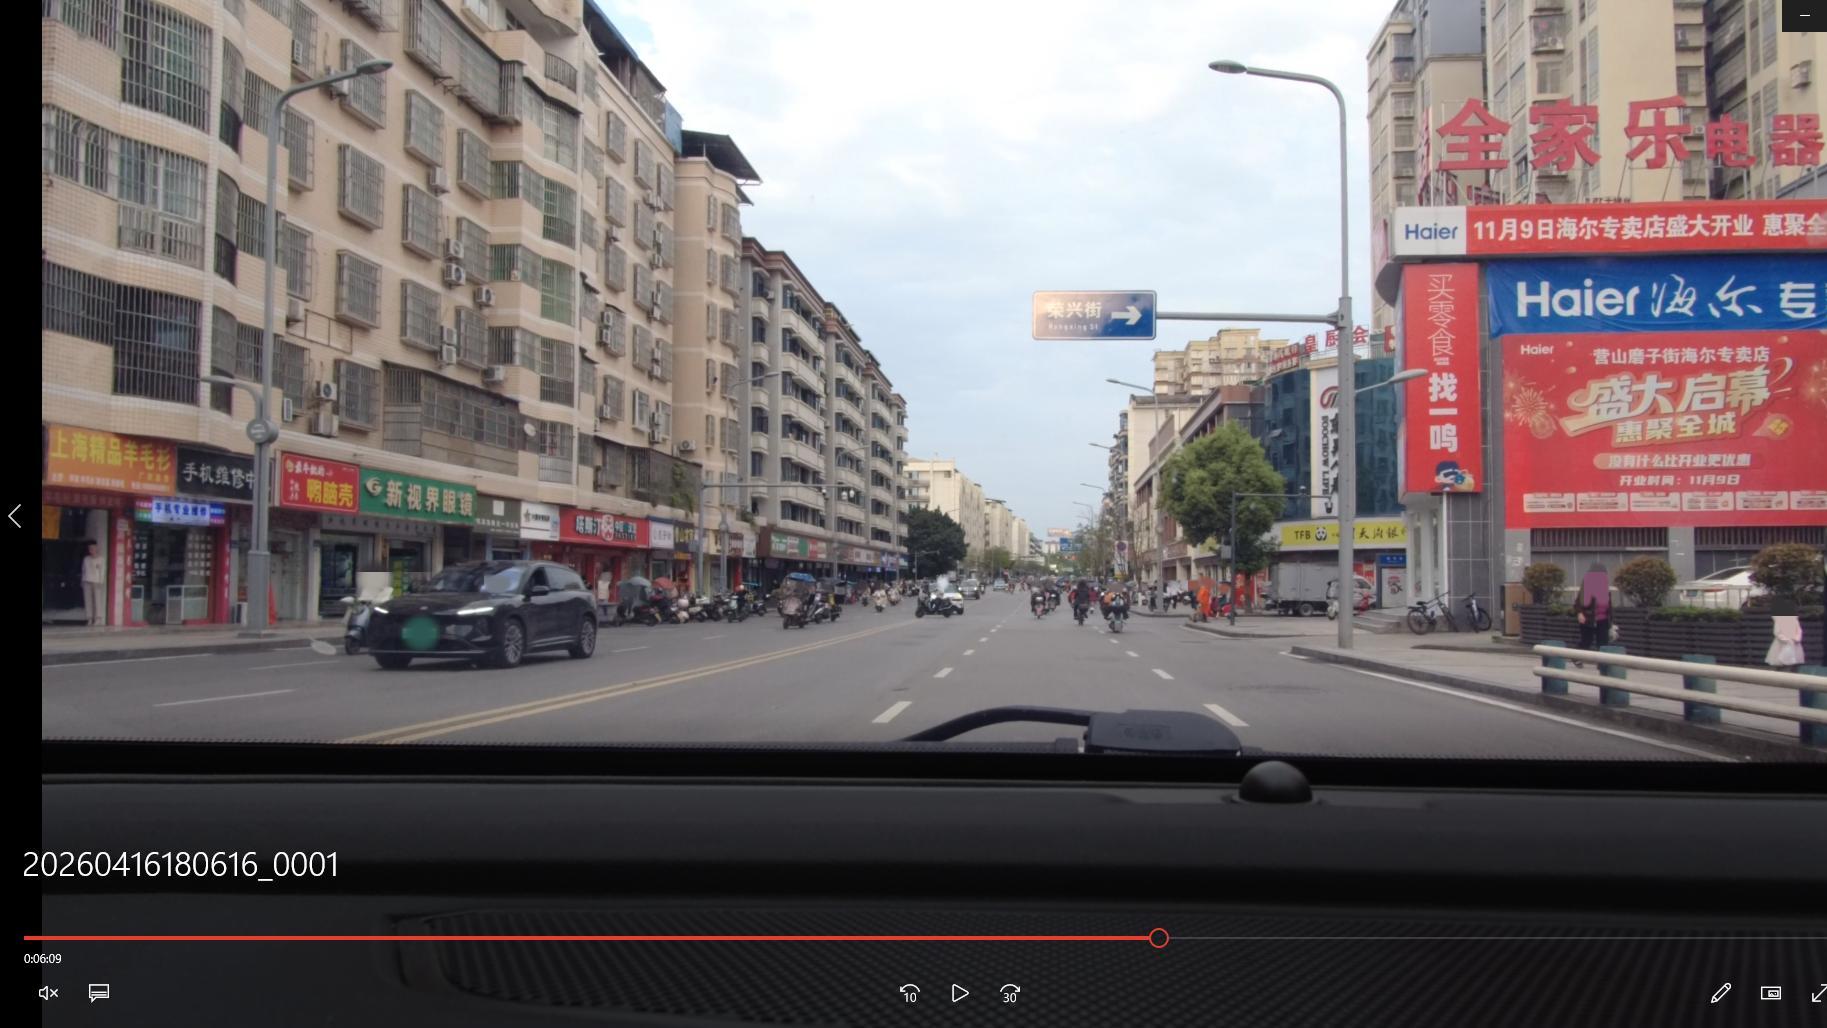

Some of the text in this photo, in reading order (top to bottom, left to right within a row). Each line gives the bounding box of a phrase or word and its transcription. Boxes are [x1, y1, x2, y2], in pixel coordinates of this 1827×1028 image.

[1436, 96, 1826, 171] 全家乐电器
[1404, 222, 1458, 240] Haier
[1473, 214, 1754, 241] 11月9日海尔专卖店盛大开业
[1047, 301, 1102, 319] 荣兴街
[1517, 278, 1641, 318] Haier
[1427, 273, 1457, 357] 买零食
[1520, 344, 1554, 356] Haier
[1592, 346, 1770, 365] 营山磨子街海尔专卖店
[1567, 364, 1772, 422] 盛大启幕
[1615, 411, 1737, 444] 惠聚全城
[1608, 453, 1752, 468] 没有什么比开业更优惠
[385, 479, 473, 517] 新视界眼镜
[1294, 530, 1311, 540] TFB
